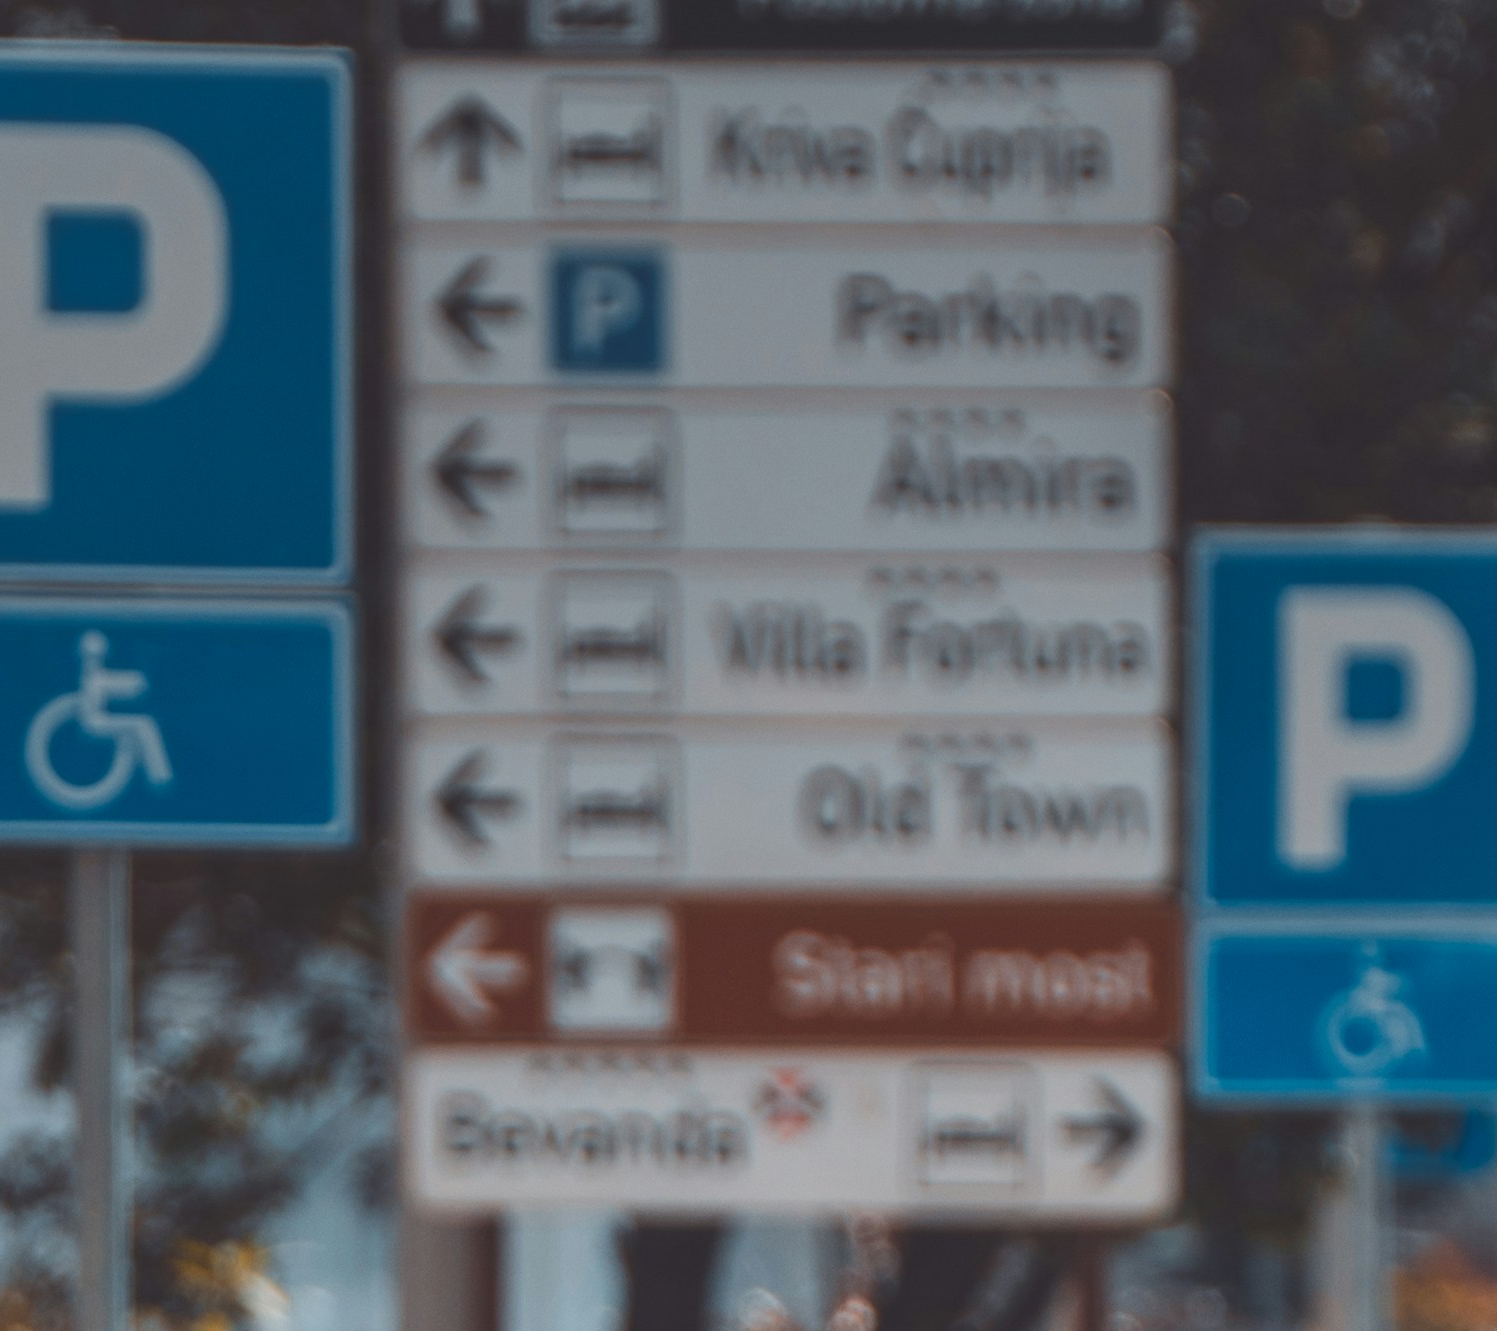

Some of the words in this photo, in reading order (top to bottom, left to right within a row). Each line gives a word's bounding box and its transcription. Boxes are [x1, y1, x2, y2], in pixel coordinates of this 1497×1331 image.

[569, 268, 645, 355] P
[834, 272, 1143, 365] Parking
[870, 438, 1134, 518] Almira
[722, 606, 863, 683] Villa
[1273, 582, 1477, 876] P
[799, 764, 935, 852] Old
[949, 764, 1151, 846] Town
